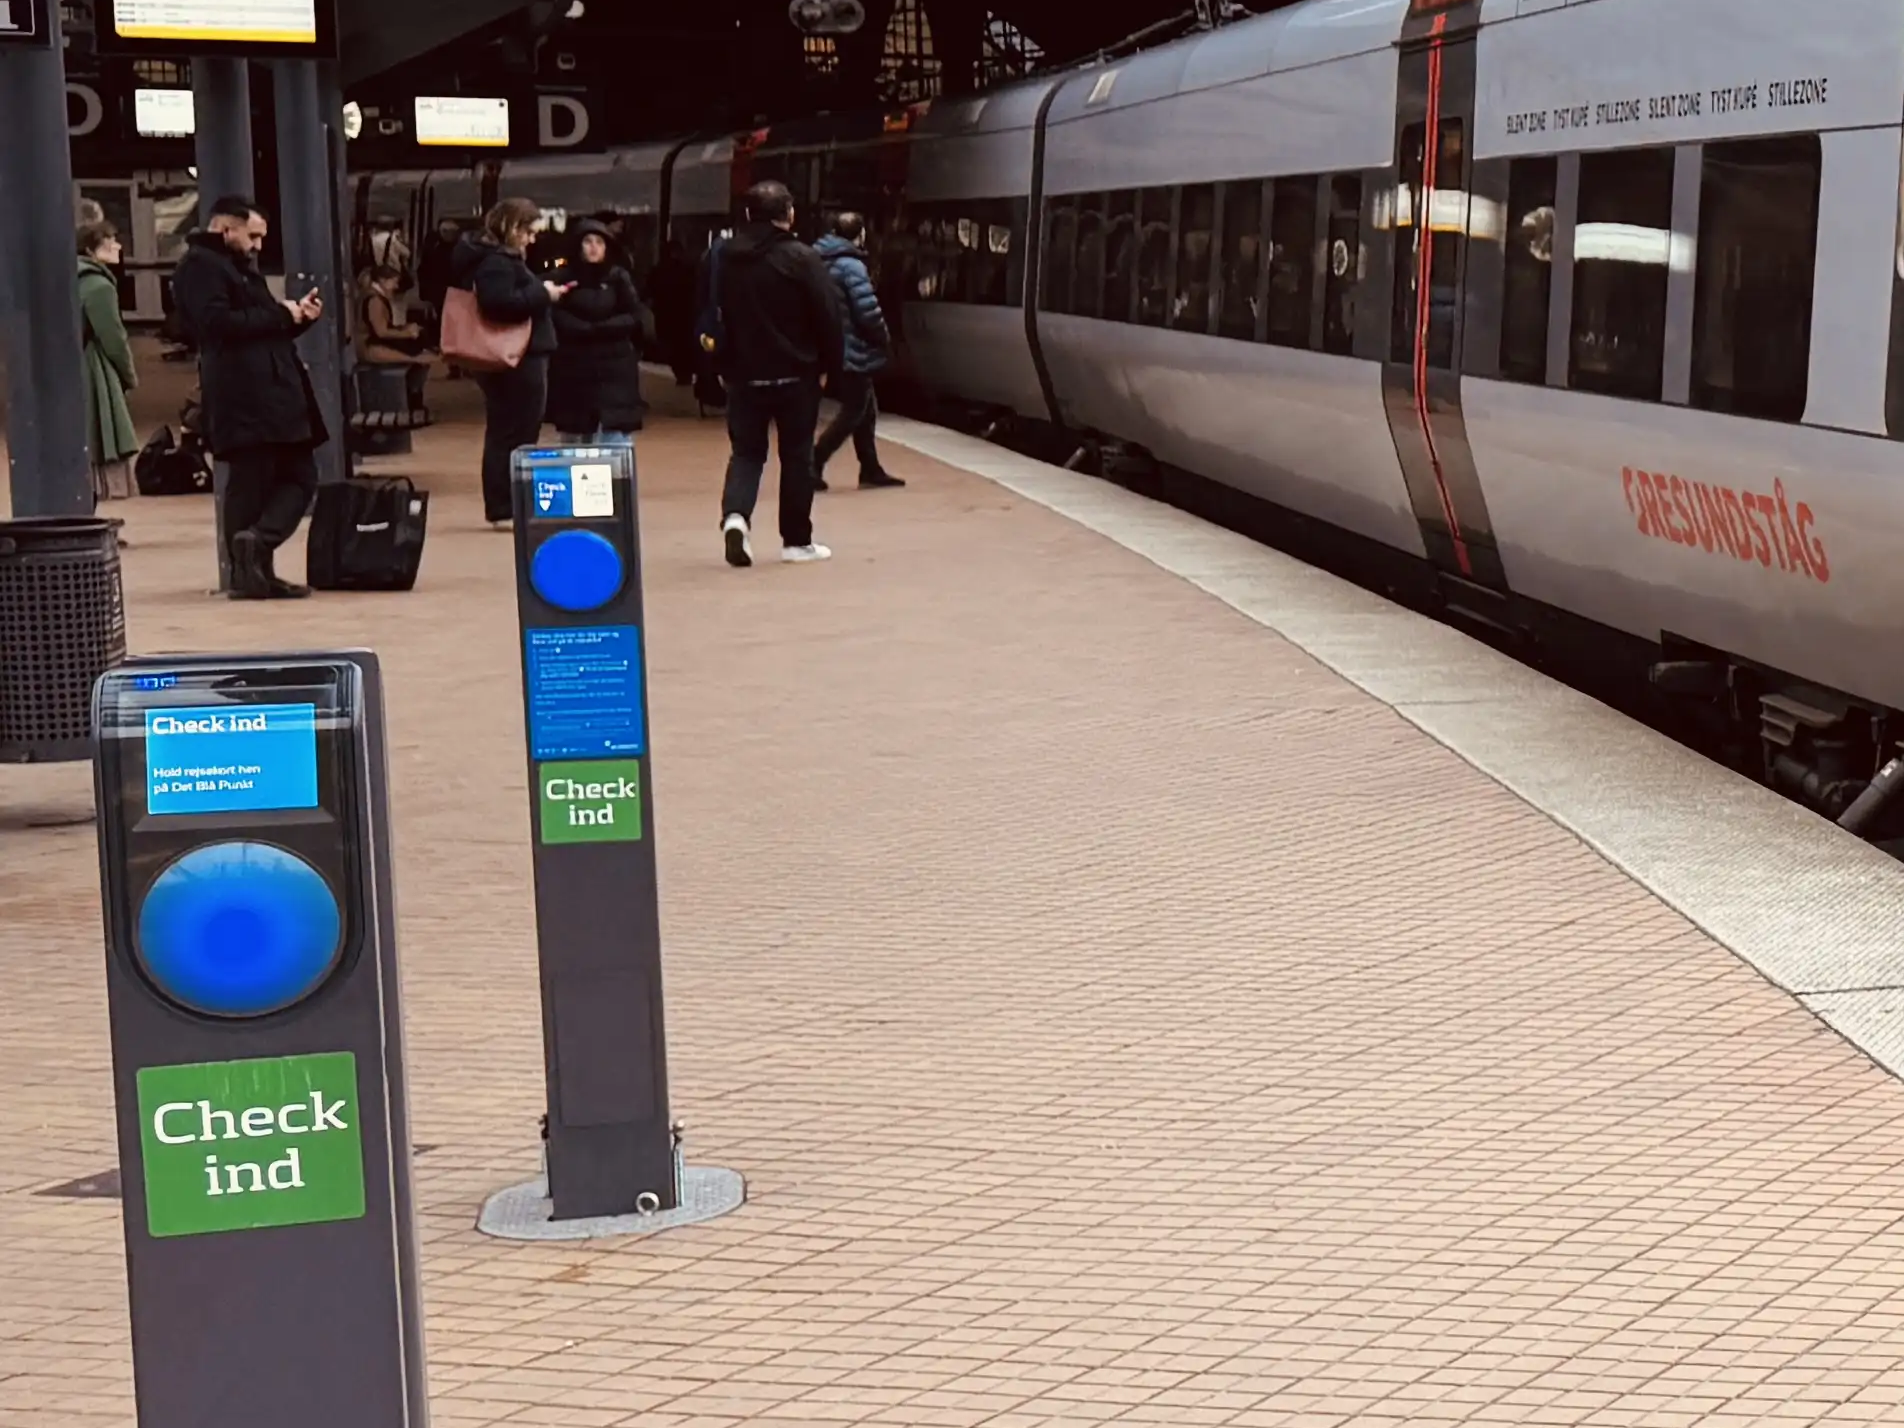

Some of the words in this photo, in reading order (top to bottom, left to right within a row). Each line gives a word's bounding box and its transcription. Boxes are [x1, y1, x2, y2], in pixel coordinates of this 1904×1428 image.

[1596, 99, 1641, 125] STILLEZONE
[1649, 94, 1677, 119] SILENT
[1677, 92, 1701, 117] ZONE
[1711, 88, 1732, 114] TYST
[1768, 77, 1828, 108] STILLEZONE
[538, 95, 590, 146] D
[152, 715, 225, 735] Check
[229, 712, 267, 732] ind
[153, 766, 181, 778] Hold
[153, 782, 168, 795] på
[171, 781, 193, 793] Det
[195, 779, 217, 792] Blå
[218, 778, 254, 791] Punkt
[546, 776, 636, 801] Check
[568, 803, 615, 826] ind
[154, 1090, 348, 1144] Check
[203, 1147, 306, 1196] ind
